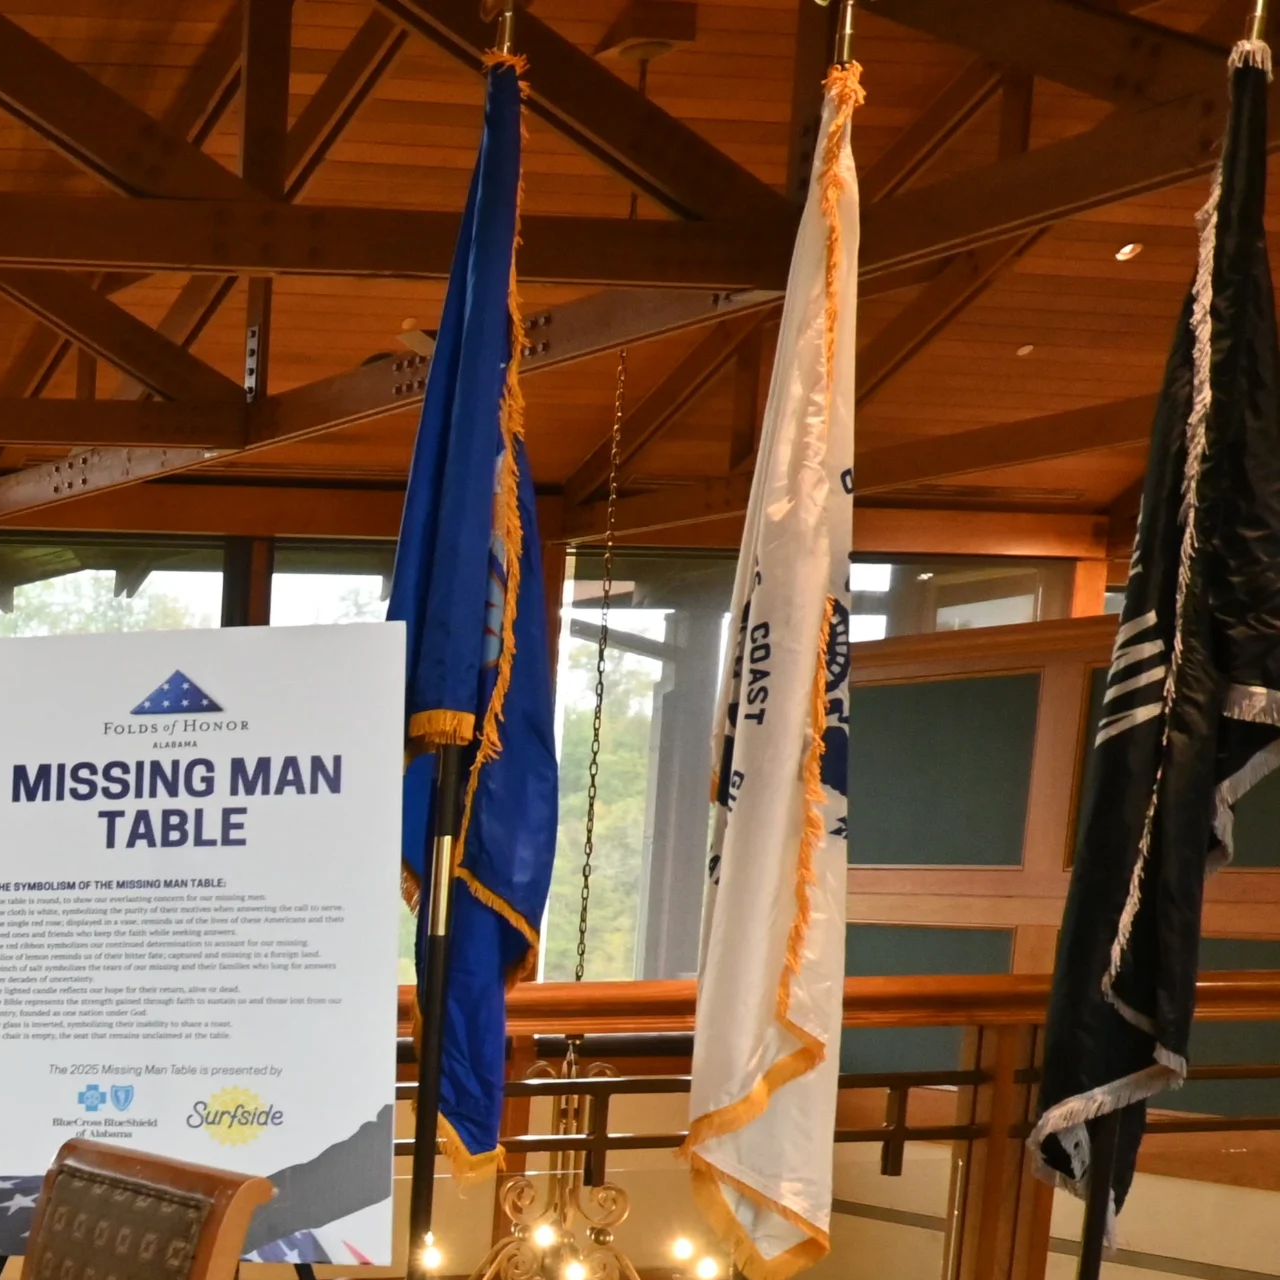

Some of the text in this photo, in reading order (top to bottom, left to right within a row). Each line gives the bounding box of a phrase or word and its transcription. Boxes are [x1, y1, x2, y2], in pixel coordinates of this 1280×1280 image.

[744, 621, 770, 725] COAST
[163, 720, 178, 736] of
[152, 740, 198, 749] ALABAMA
[11, 754, 342, 802] MISSING MAN
[98, 806, 248, 848] TABLE
[13, 880, 76, 891] SYMBOLISM
[78, 880, 92, 890] OF
[94, 880, 114, 890] THE
[116, 880, 160, 890] MISSING
[163, 878, 188, 888] MAN
[190, 878, 226, 888] TABLE:
[50, 1064, 283, 1077] The 2025 Missing Man Table is presented by
[186, 1100, 284, 1129] Surfside
[52, 1118, 158, 1127] BlueCross BlueShield
[75, 1129, 132, 1138] of Alabama
